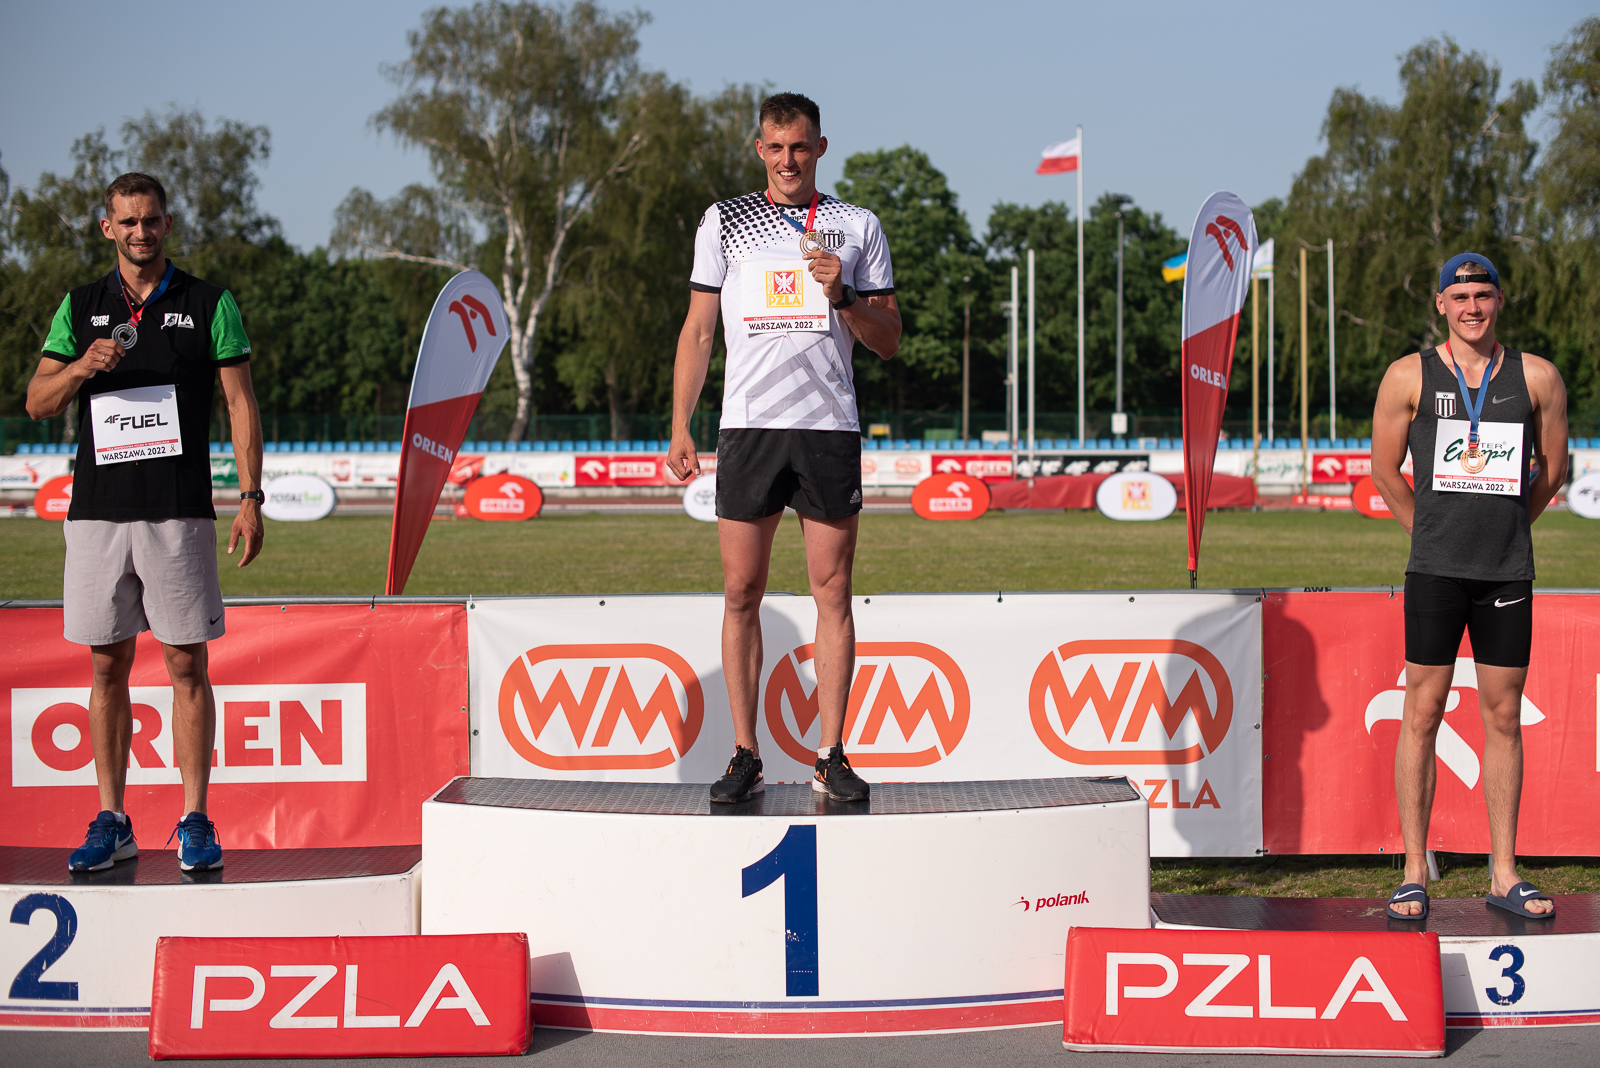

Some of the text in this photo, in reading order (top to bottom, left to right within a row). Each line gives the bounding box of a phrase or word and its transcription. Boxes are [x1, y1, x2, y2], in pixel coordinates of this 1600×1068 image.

[768, 294, 801, 306] PZLA
[748, 321, 814, 330] WARSZAWA 2022
[120, 413, 169, 431] FUEL
[101, 446, 166, 461] WARSZAWA 2022
[412, 432, 454, 465] ORLEN
[1439, 480, 1505, 492] WARSZAWA 2022
[31, 699, 343, 772] OREN
[1131, 778, 1221, 809] ZLA
[741, 824, 820, 997] 1
[1034, 889, 1090, 912] polanik
[9, 893, 79, 1002] 2
[1105, 951, 1409, 1022] PZLA
[1485, 944, 1526, 1007] 3
[190, 962, 492, 1030] PZLA
